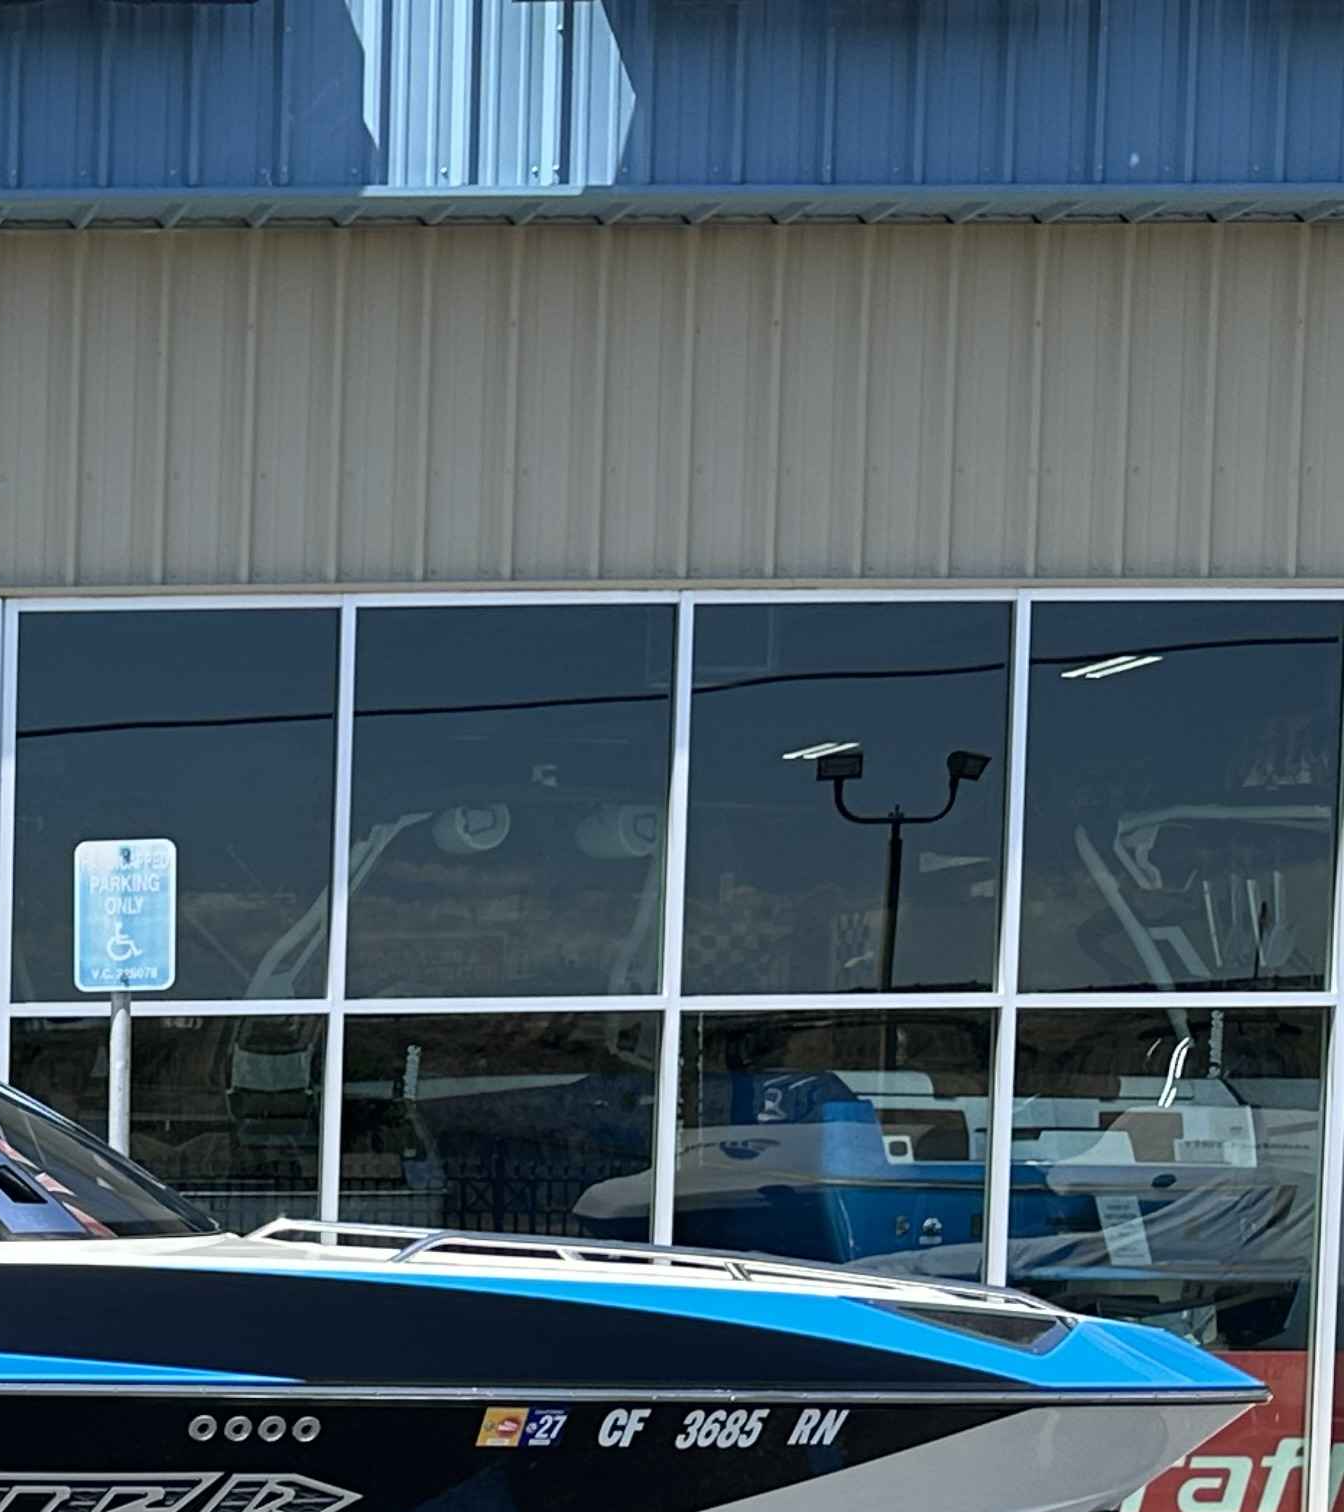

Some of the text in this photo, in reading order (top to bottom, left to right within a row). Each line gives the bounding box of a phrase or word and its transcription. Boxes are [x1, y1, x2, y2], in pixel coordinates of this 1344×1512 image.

[88, 874, 161, 894] PARKING
[104, 896, 145, 915] ONLY
[535, 1414, 568, 1439] 27
[598, 1408, 851, 1450] CF 3685 RN
